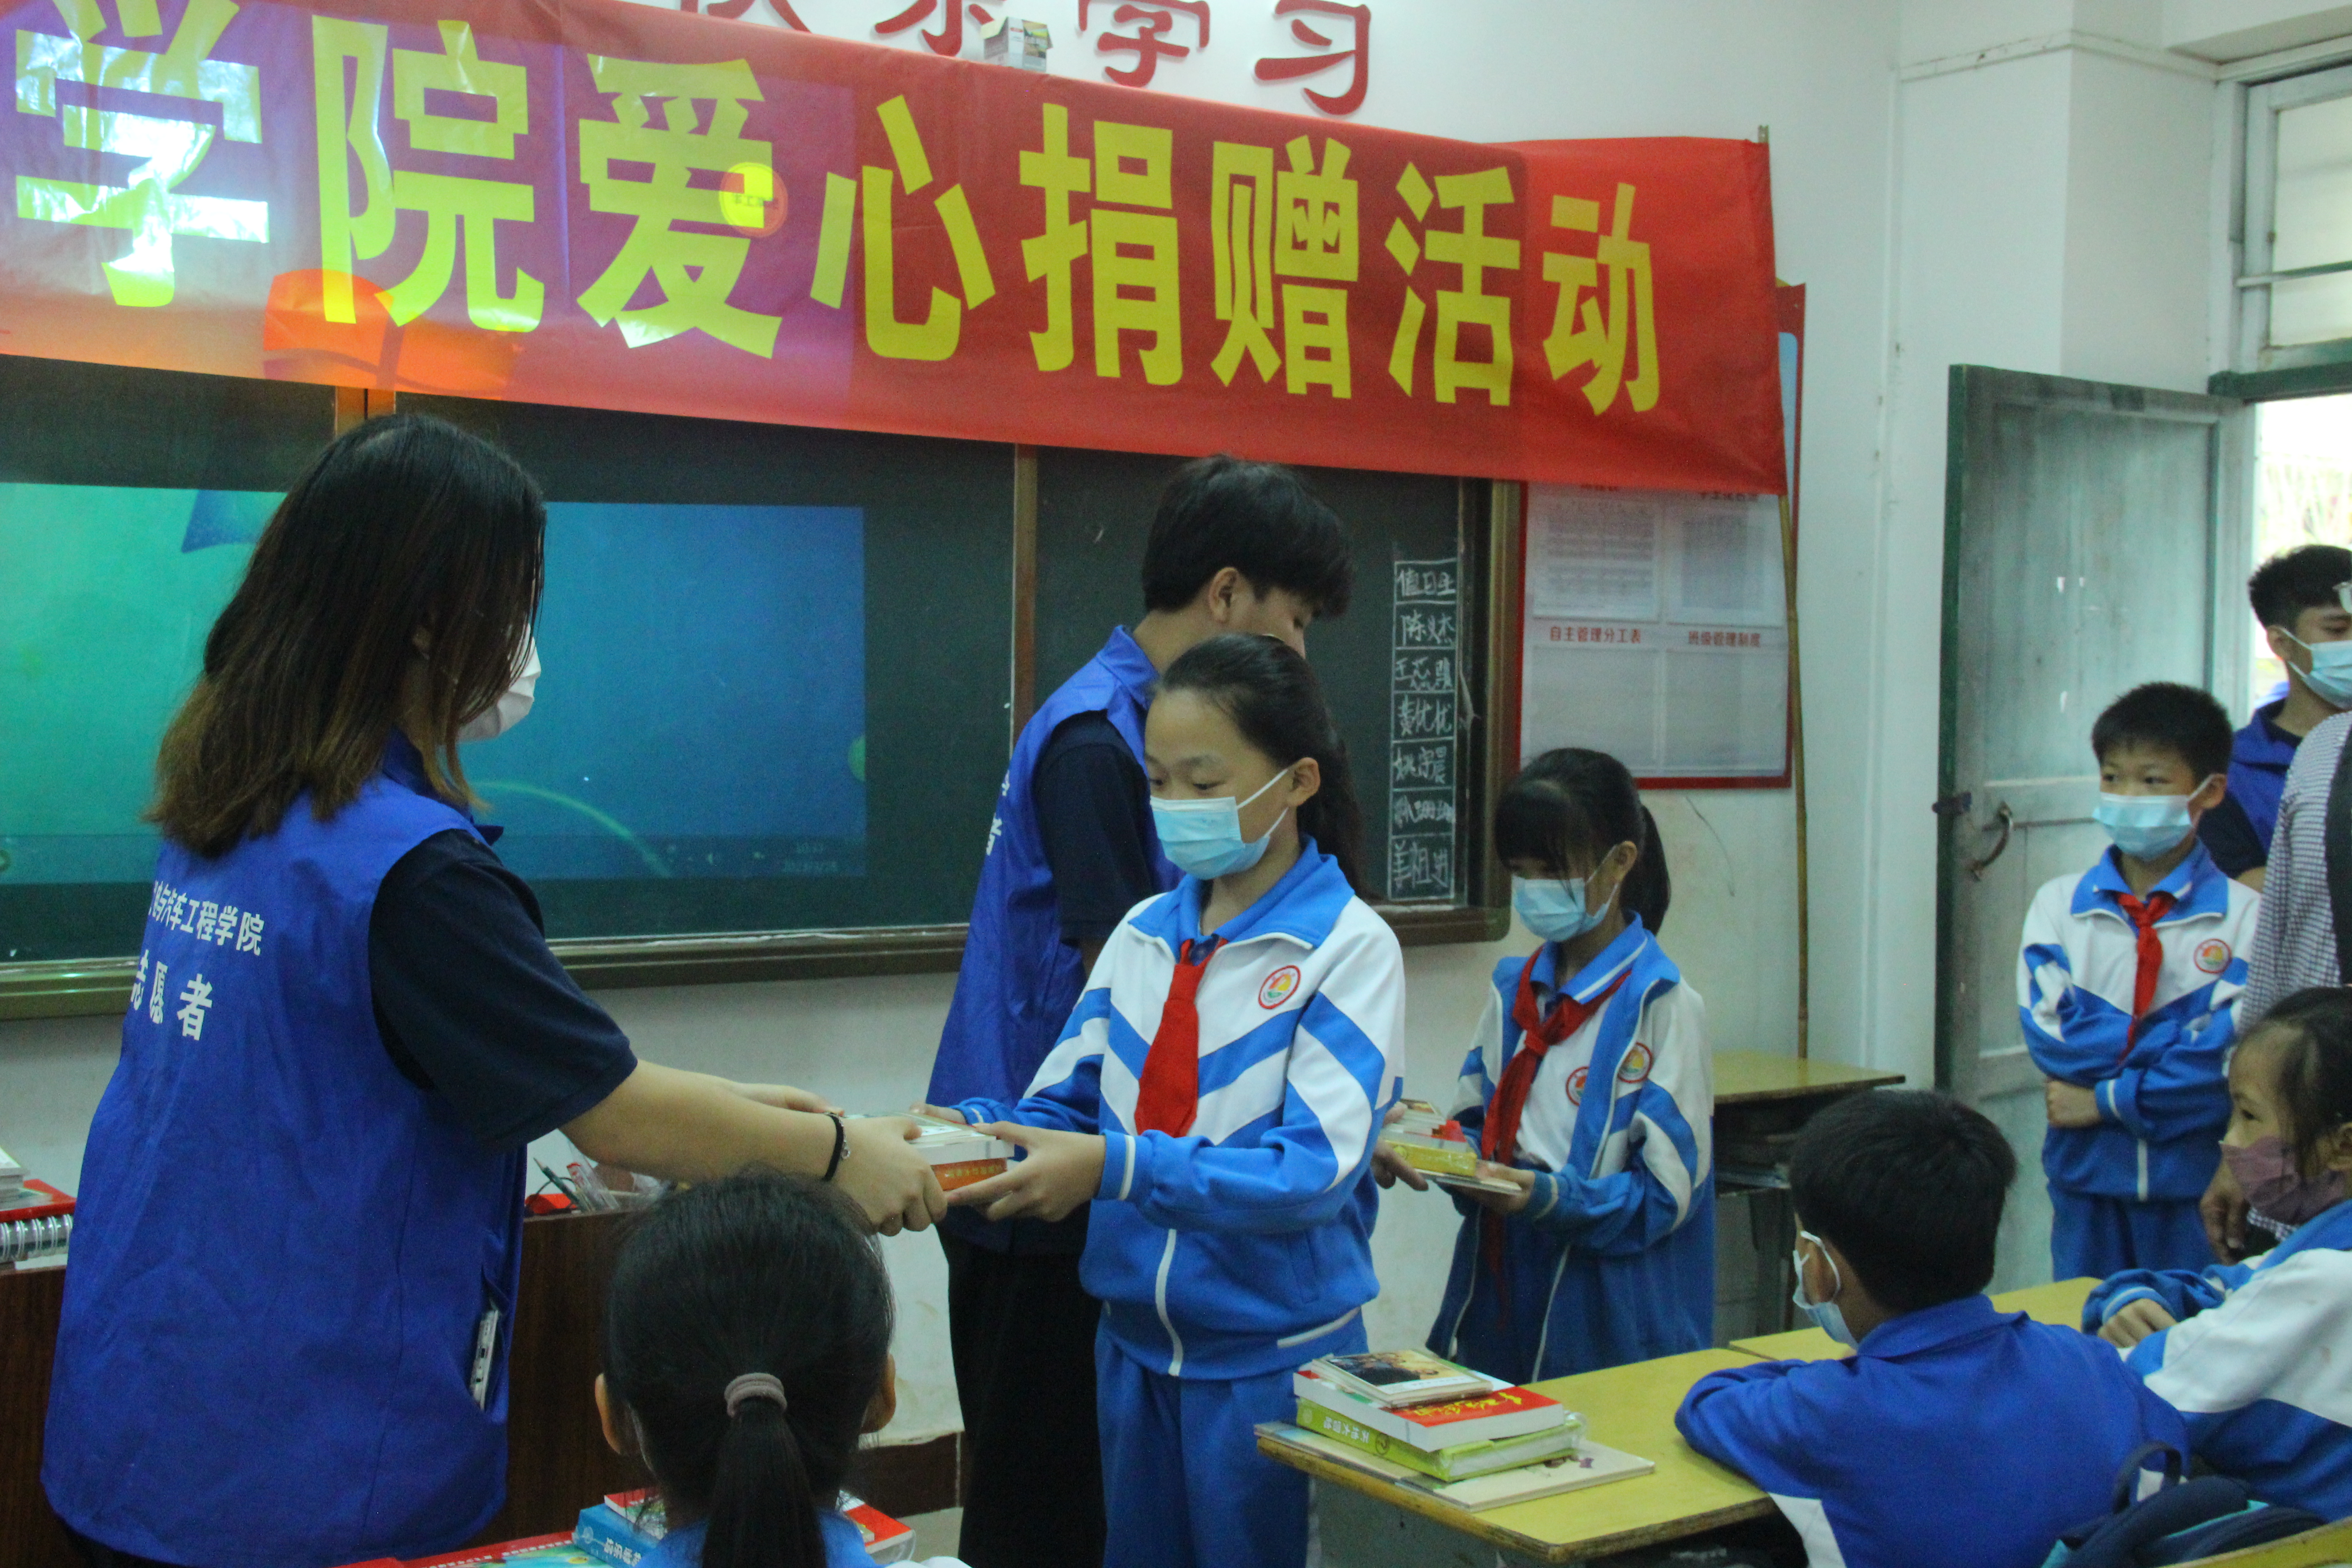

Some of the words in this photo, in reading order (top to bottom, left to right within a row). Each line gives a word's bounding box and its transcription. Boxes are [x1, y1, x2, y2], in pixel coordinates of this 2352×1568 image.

[16, 0, 1660, 416] 学院爱心捐赠活动
[1396, 568, 1456, 597] 值日生
[130, 949, 213, 1041] 志愿者
